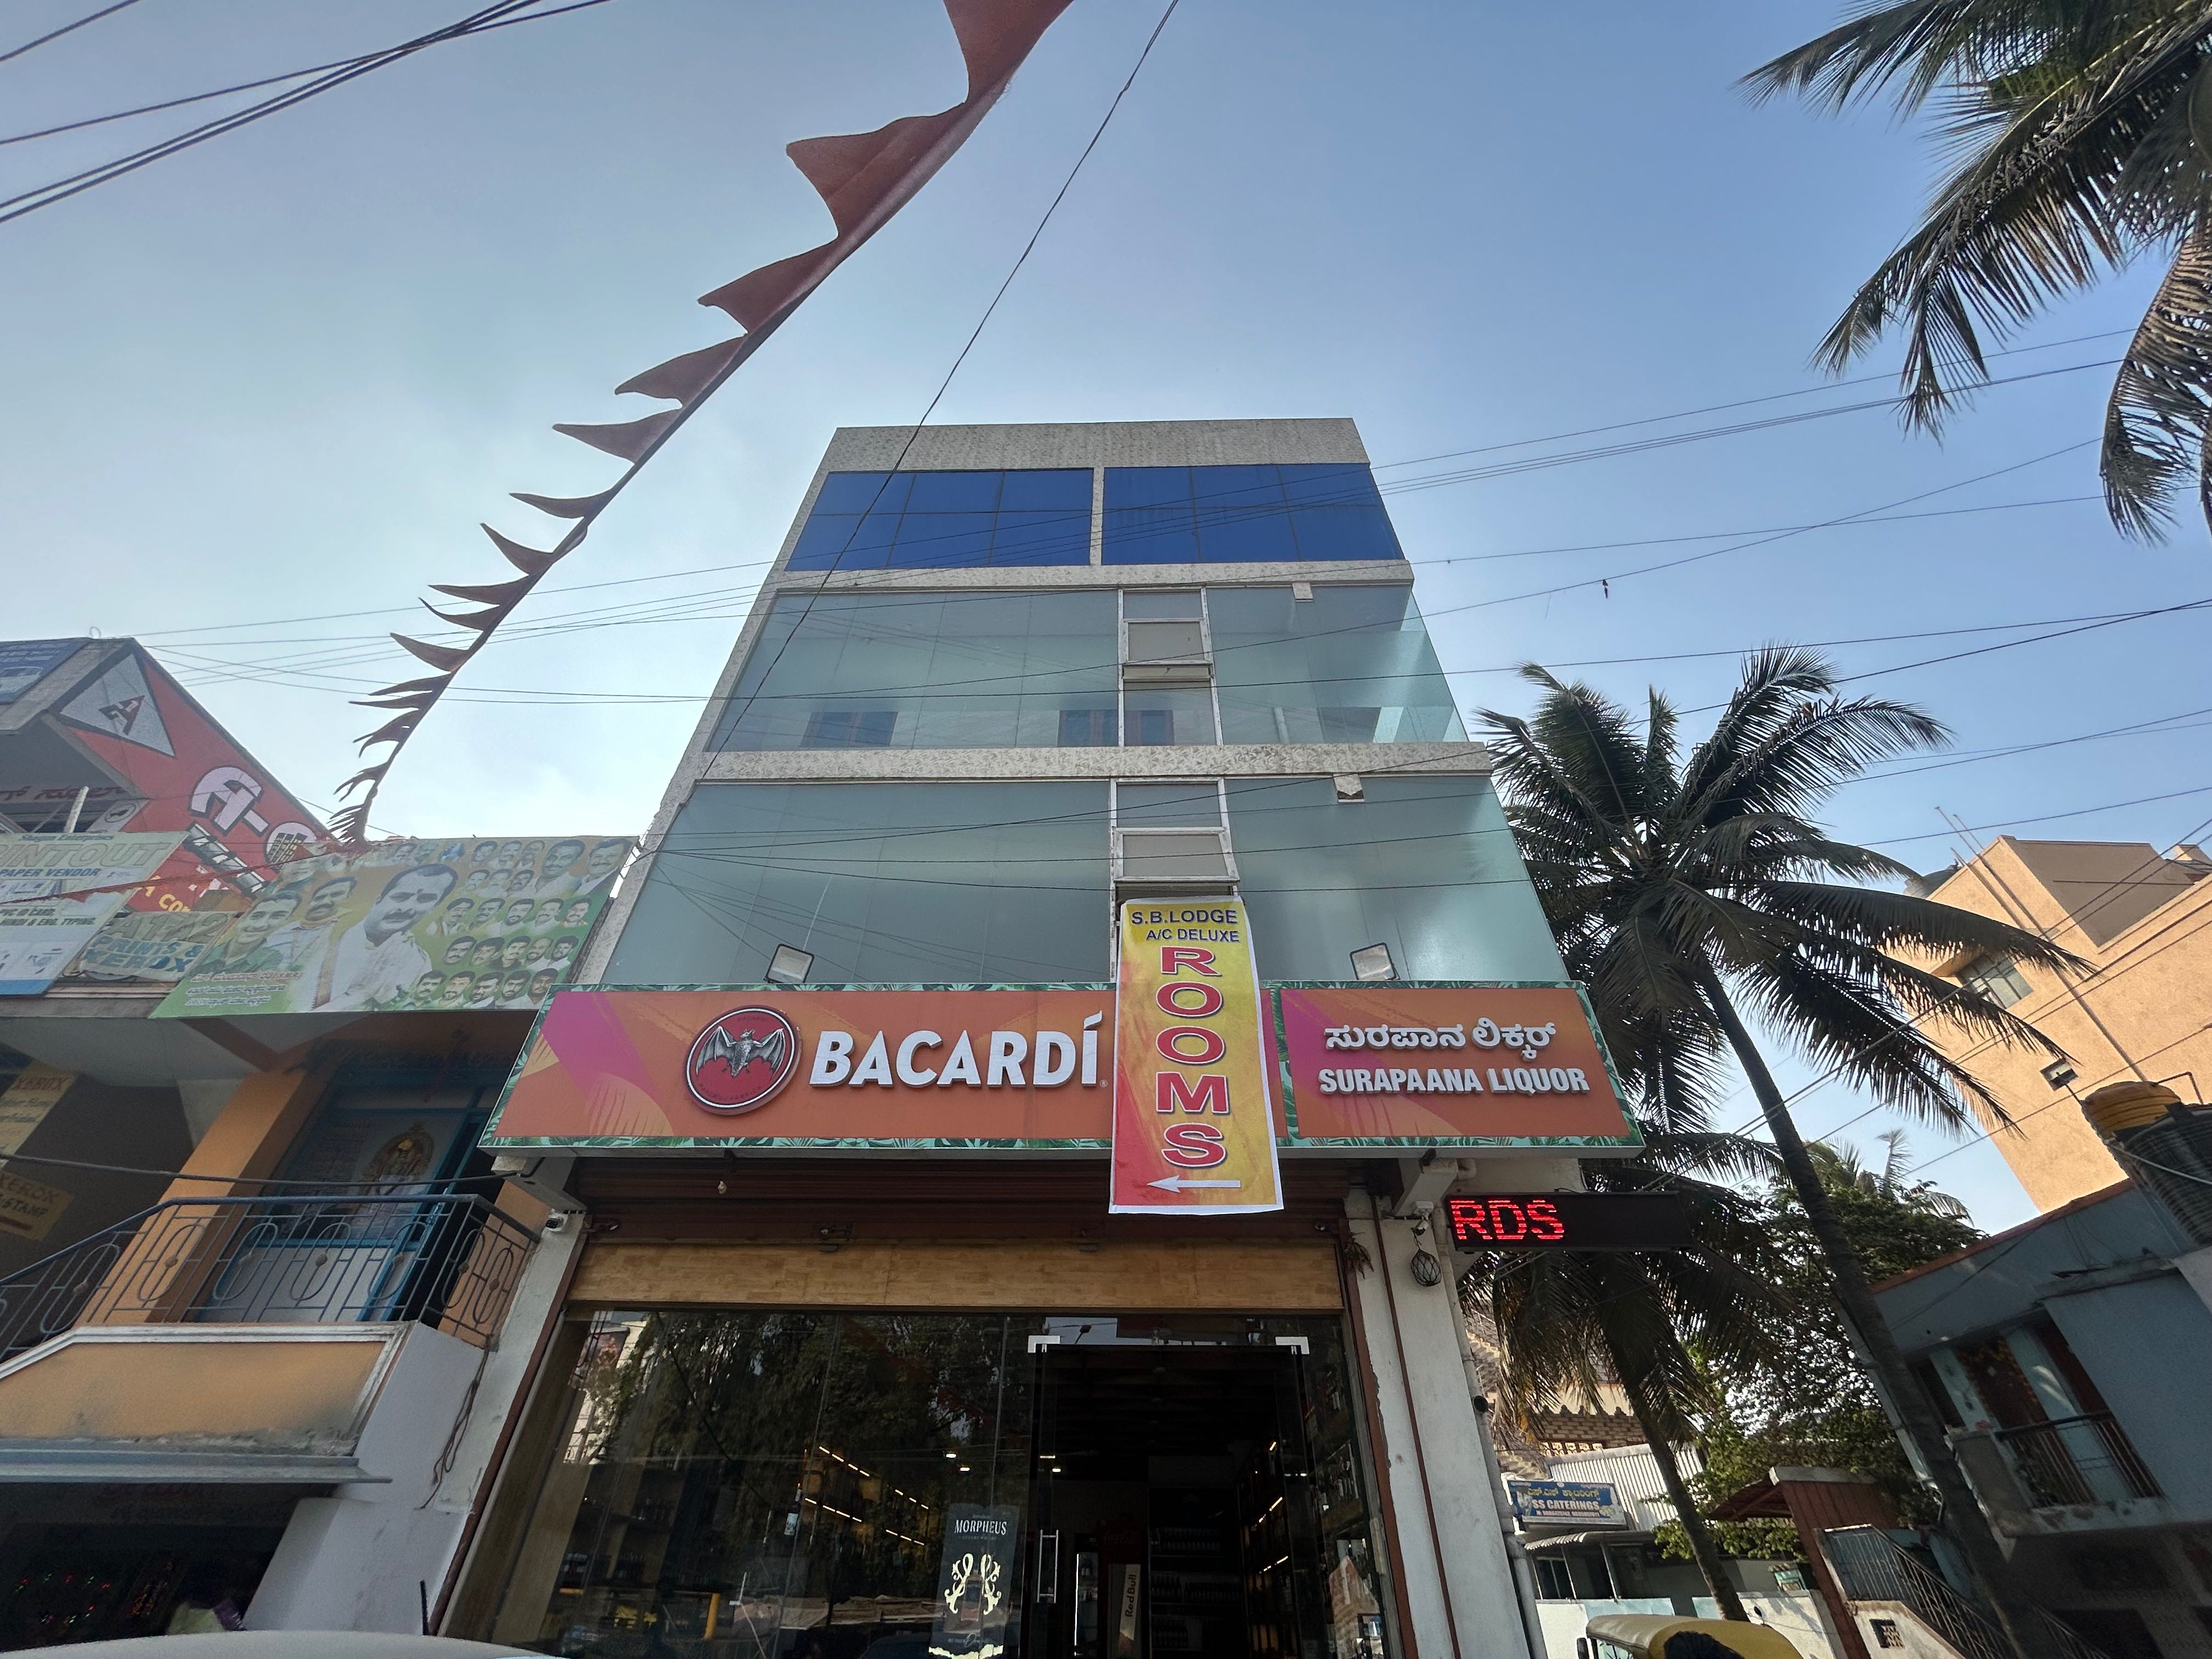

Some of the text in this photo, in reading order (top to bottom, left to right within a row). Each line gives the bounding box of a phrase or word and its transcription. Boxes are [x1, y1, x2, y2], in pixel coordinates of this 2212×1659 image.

[0, 843, 172, 867] INTOUT
[45, 868, 101, 877] VENDOR
[1131, 909, 1239, 925] S.B.LODGE
[91, 935, 181, 954] PRINTS
[1146, 928, 1240, 943] A/C DELUXE
[809, 1010, 1103, 1088] BACARDÍ
[1323, 1016, 1556, 1063] ಸುರಪಾನ ಲಿಕ್ಕರ್
[1155, 945, 1231, 1169] ROOMS
[1318, 1067, 1590, 1097] SURAPAANA LIQUOR
[1449, 1200, 1565, 1240] RDS
[1532, 1499, 1600, 1510] SS CATERINGS
[953, 1519, 1007, 1536] MORPHEUS
